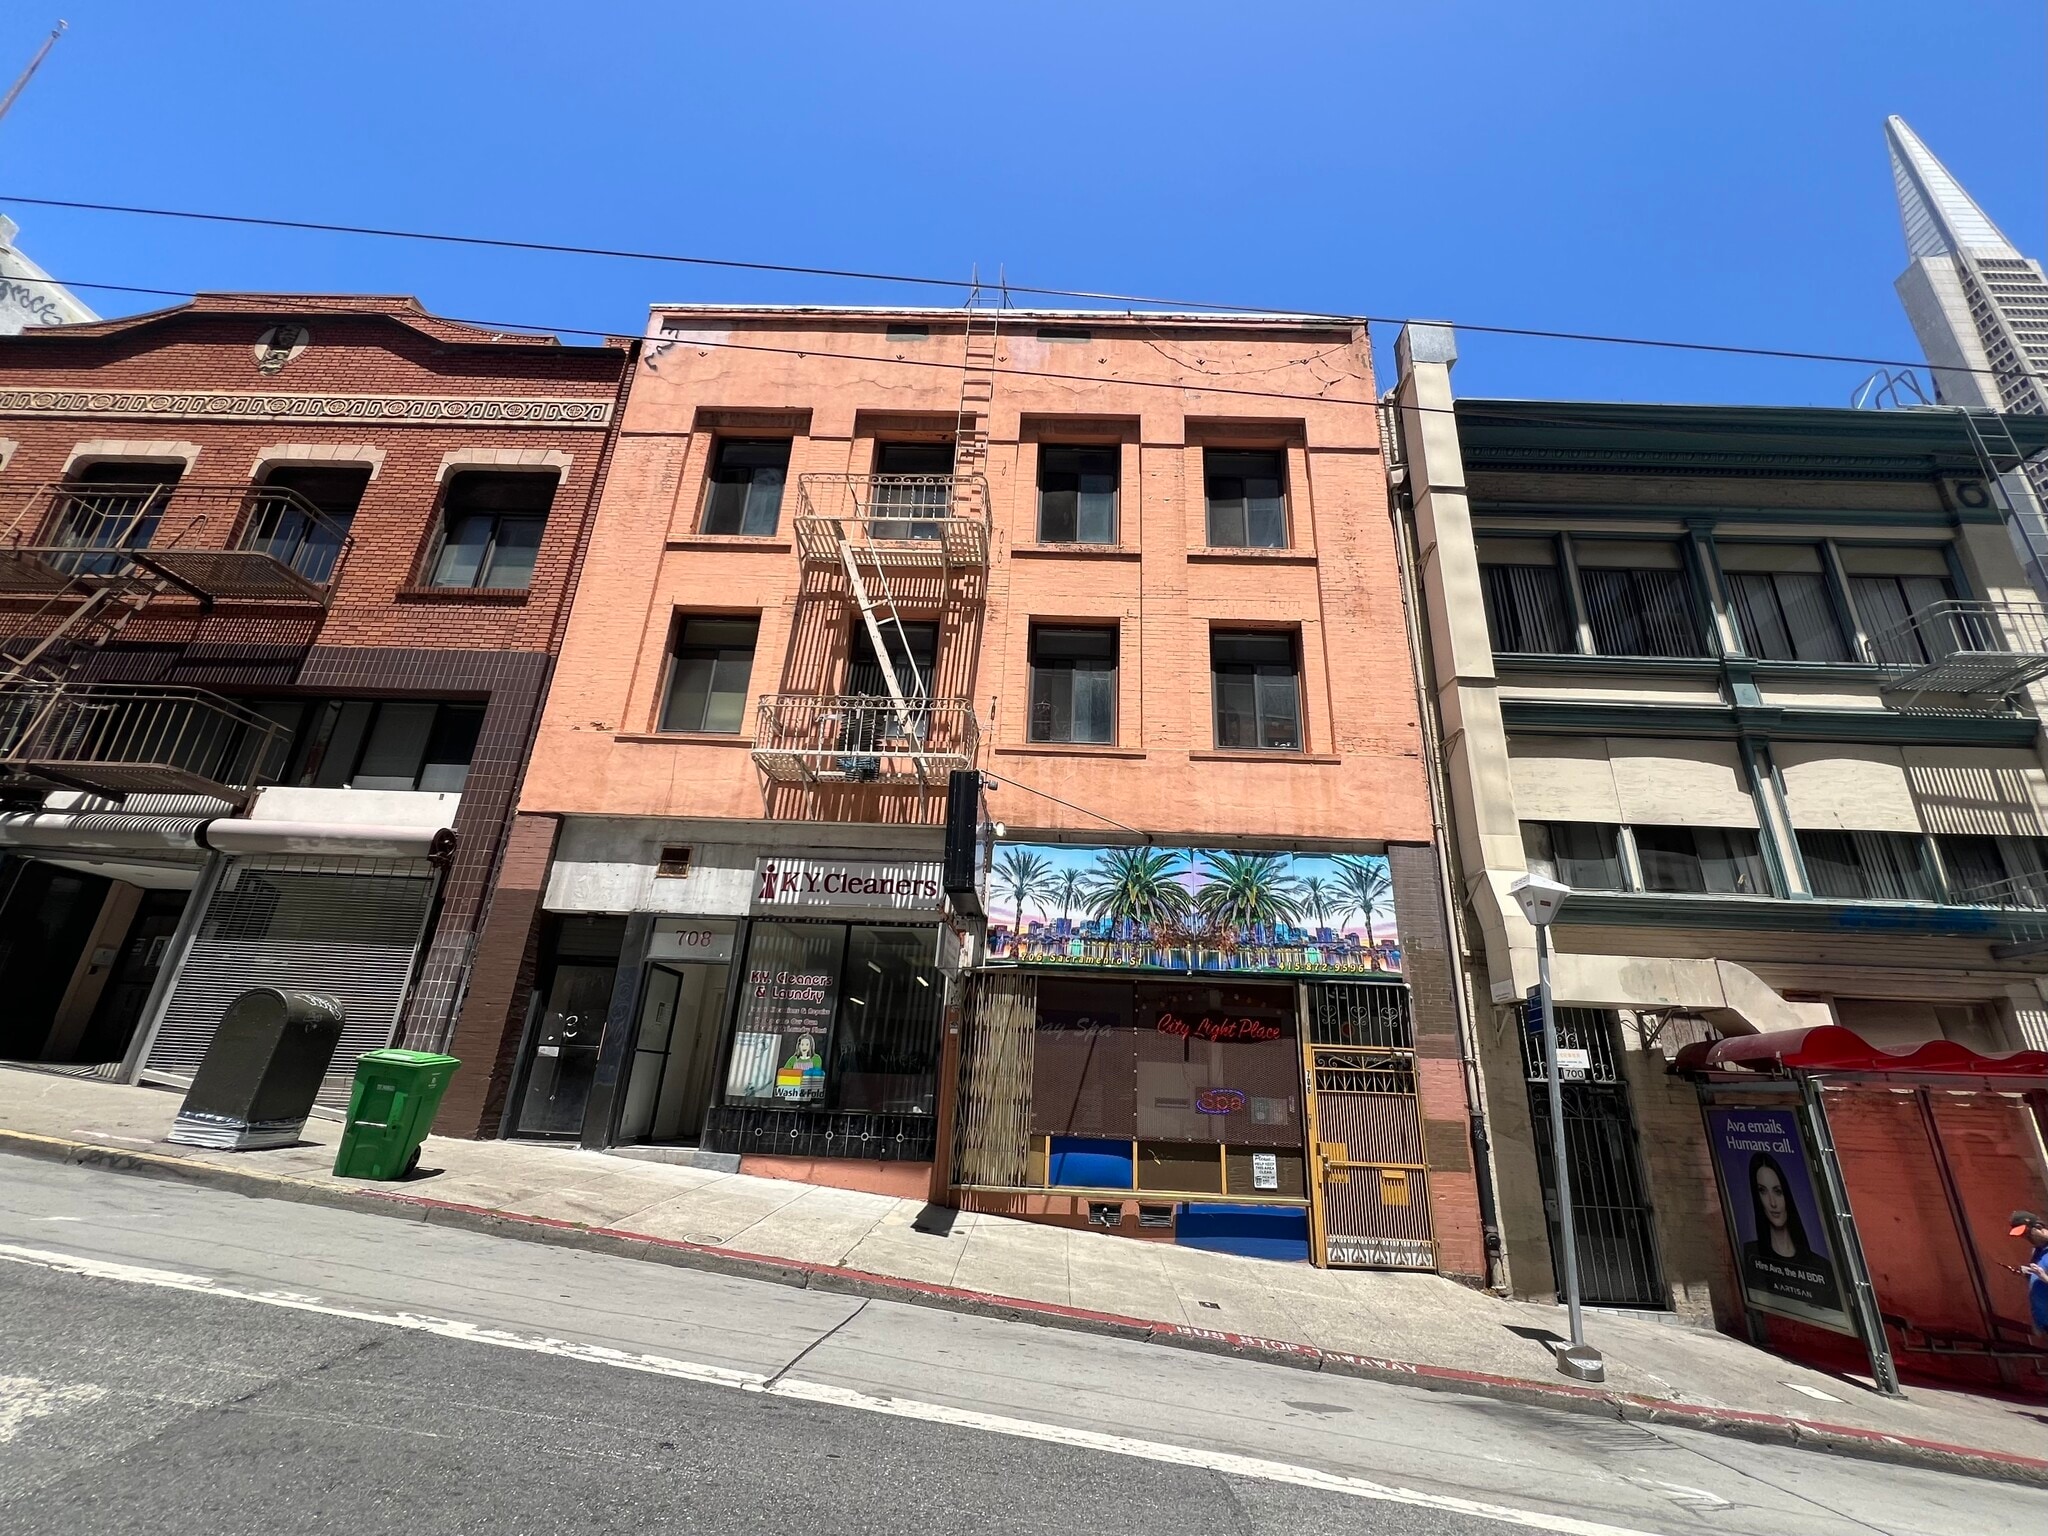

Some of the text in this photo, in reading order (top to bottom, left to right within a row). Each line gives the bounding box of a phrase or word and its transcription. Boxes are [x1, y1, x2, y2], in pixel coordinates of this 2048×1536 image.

[780, 872, 937, 897] K.Y. Cleaners
[675, 930, 712, 947] 708
[1021, 952, 1142, 968] 706 Sacramento St
[1279, 962, 1364, 973] 415-872-9596
[776, 971, 833, 986] Cleaners
[755, 985, 825, 1004] & Laundry
[1073, 1016, 1115, 1042] Spa
[1157, 1013, 1281, 1041] City Light Place
[1565, 1069, 1584, 1078] 700
[774, 1087, 798, 1098] Wash
[806, 1088, 826, 1098] Fold
[1202, 1091, 1242, 1110] Spa
[1727, 1118, 1786, 1134] Ava emails.
[1725, 1135, 1795, 1154] Humans call.
[1754, 1260, 1826, 1285] Hire Ava, the AI BDR
[1780, 1285, 1813, 1298] ARTISAN
[1176, 1325, 1226, 1341] BUS
